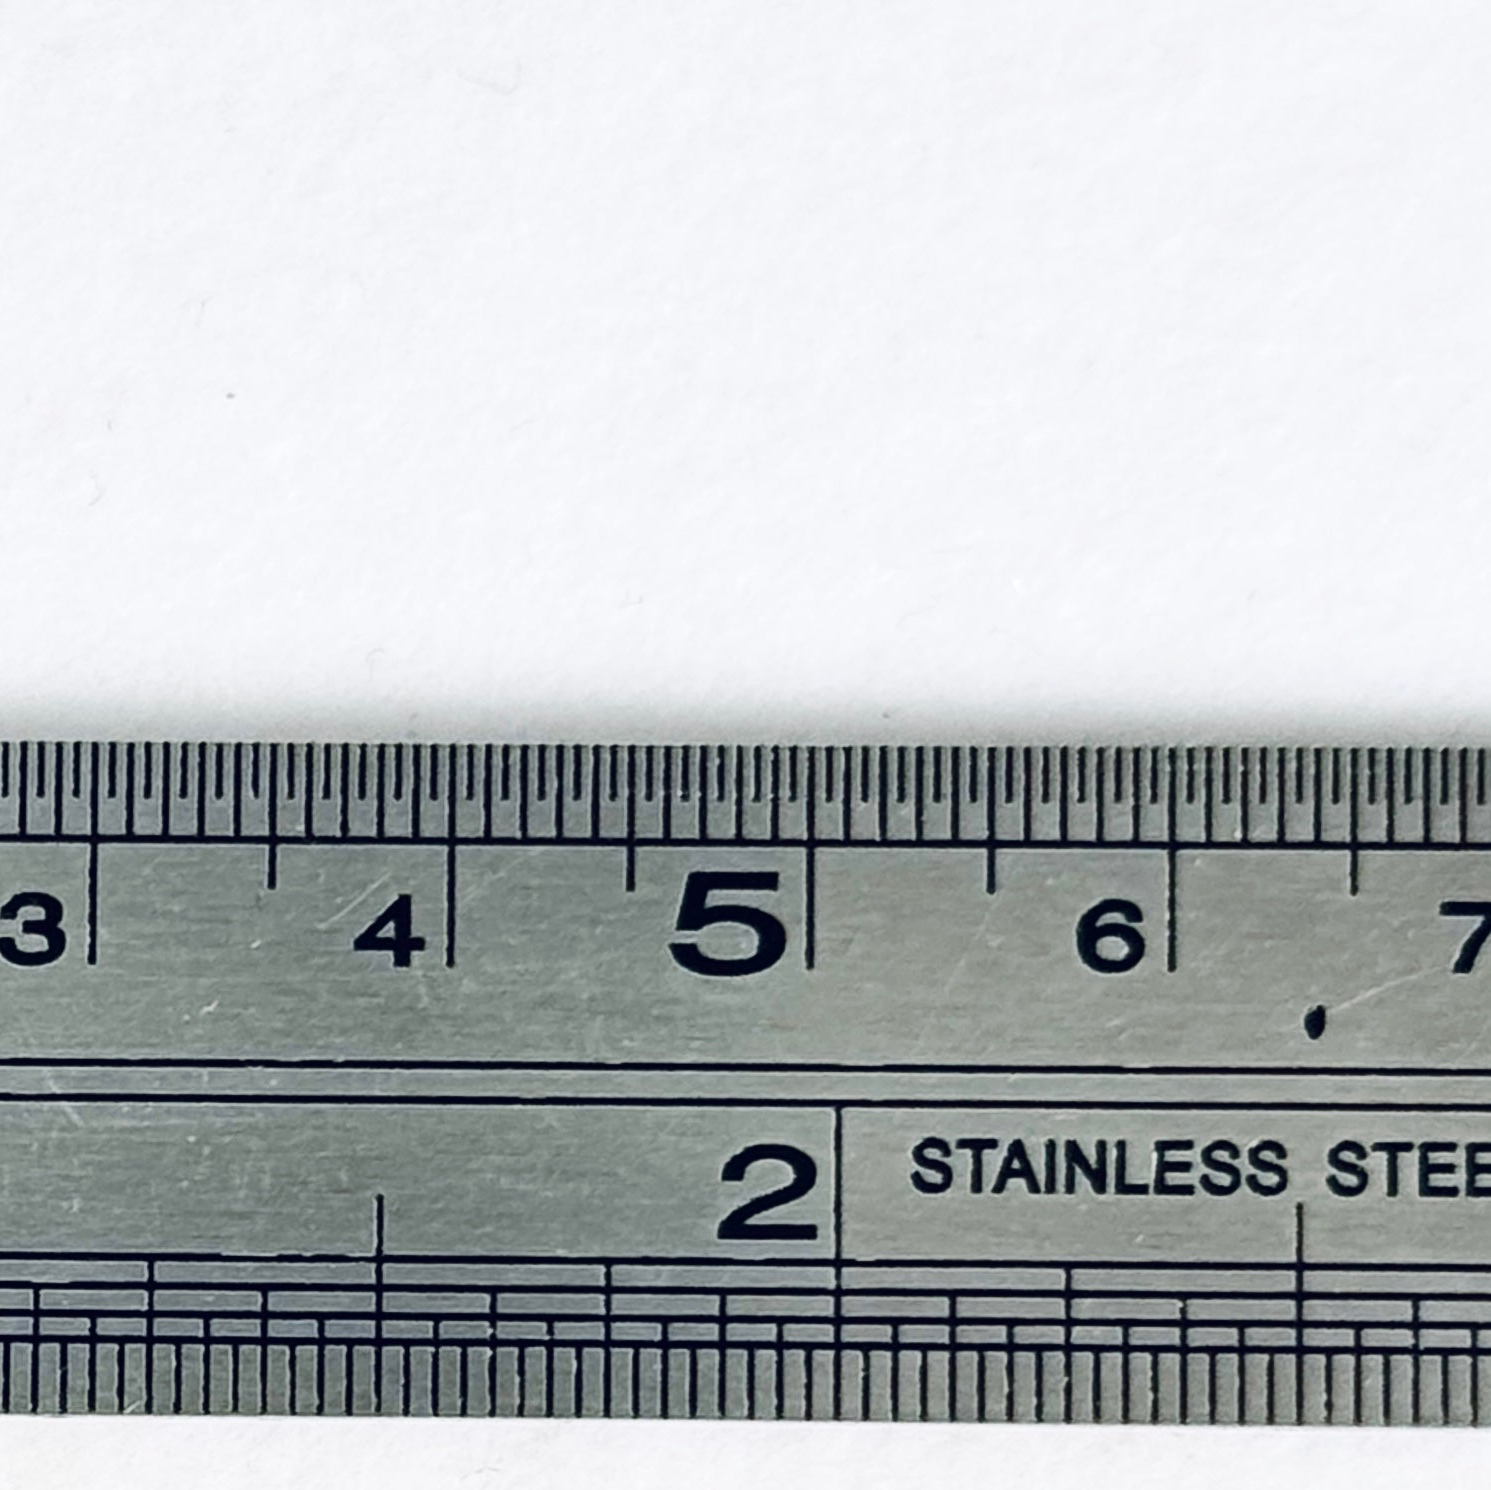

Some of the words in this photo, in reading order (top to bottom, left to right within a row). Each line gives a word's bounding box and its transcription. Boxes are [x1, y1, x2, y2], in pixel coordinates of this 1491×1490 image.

[353, 893, 427, 968] 4
[668, 870, 788, 978] 5
[1075, 898, 1147, 974] 6
[1439, 900, 1491, 974] 7
[716, 1143, 819, 1241] 2
[910, 1136, 1289, 1197] STAINLESS
